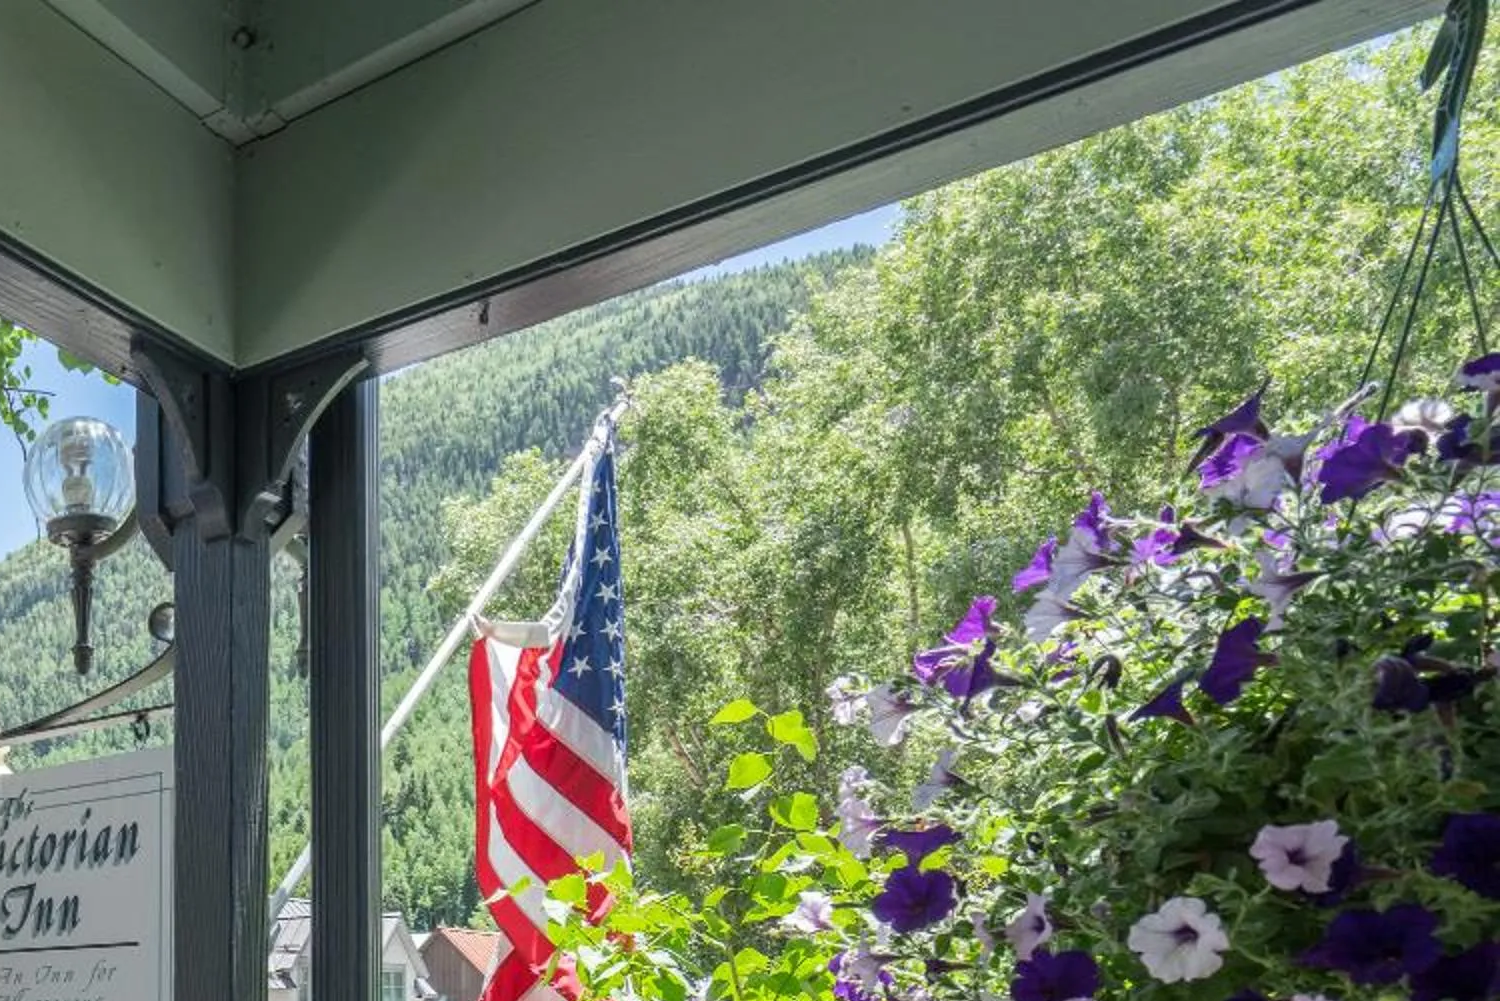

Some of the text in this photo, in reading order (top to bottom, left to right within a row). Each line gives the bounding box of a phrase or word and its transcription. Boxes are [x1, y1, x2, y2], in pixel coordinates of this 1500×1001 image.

[0, 883, 81, 939] Inn
[35, 965, 76, 985] Inn
[80, 958, 117, 992] for
